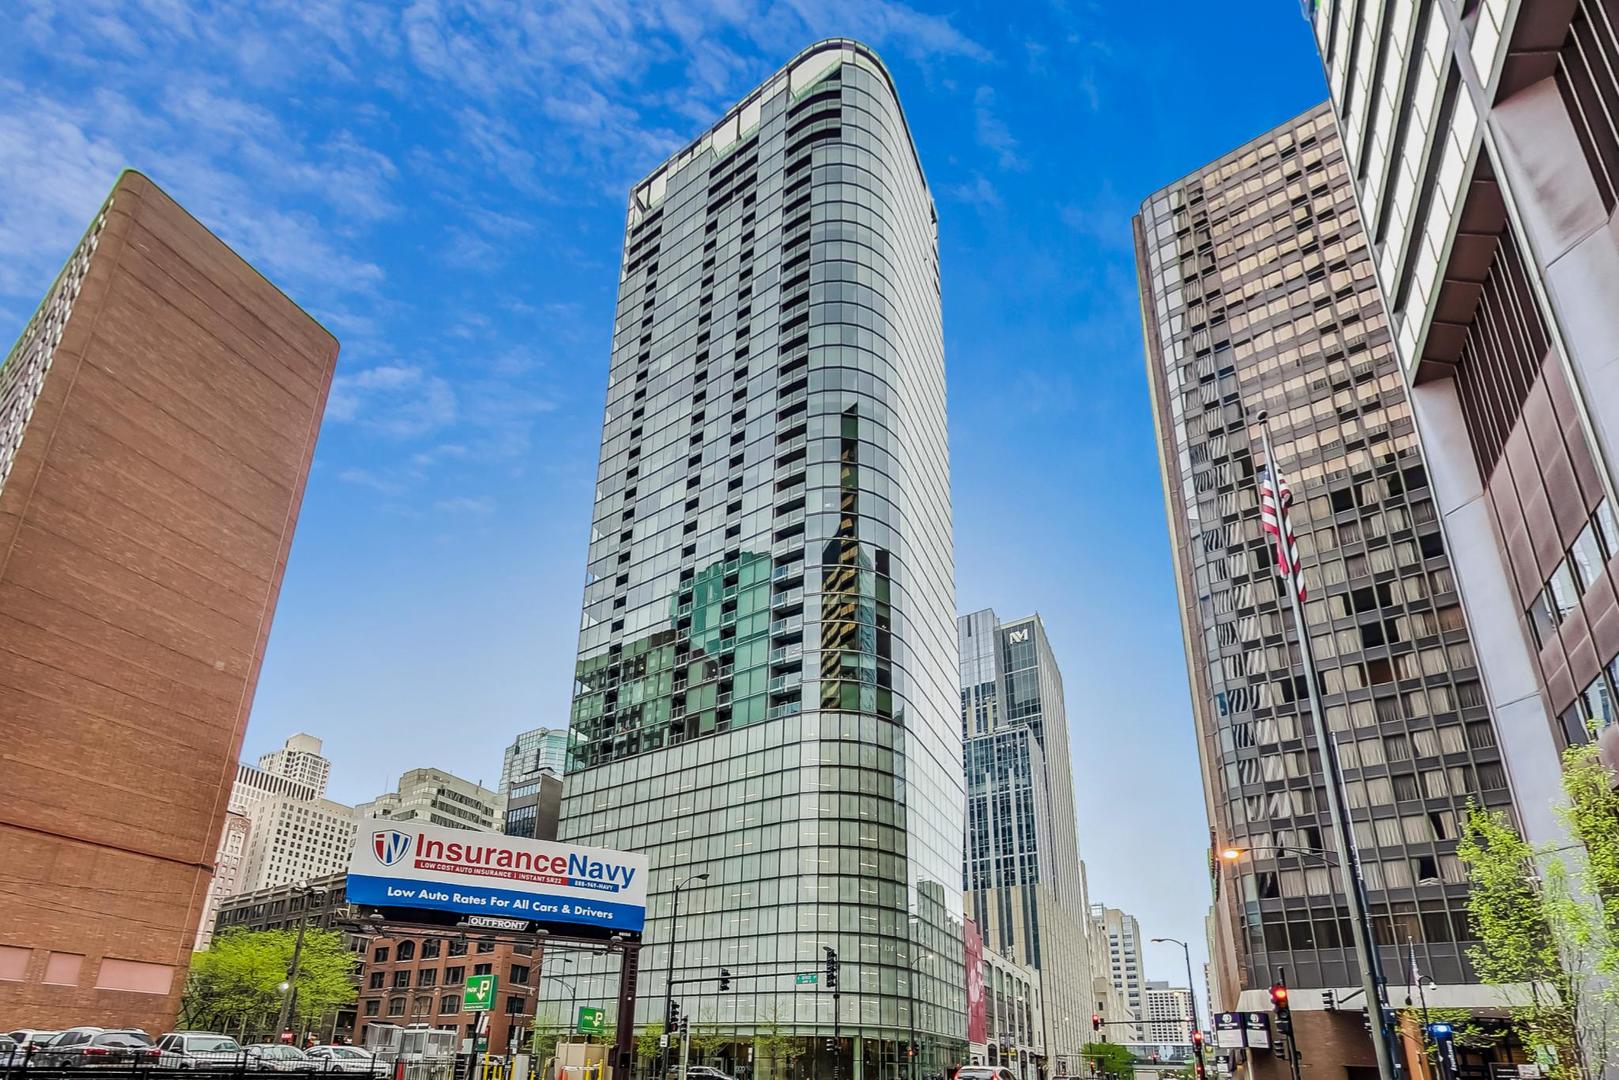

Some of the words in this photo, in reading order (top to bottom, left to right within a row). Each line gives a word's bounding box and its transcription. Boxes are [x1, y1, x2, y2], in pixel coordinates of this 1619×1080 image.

[415, 833, 636, 889] InsuranceNavy
[456, 866, 472, 874] AUTO
[474, 869, 512, 878] INSURANCE
[519, 873, 545, 882] INSTANT
[387, 886, 416, 898] Low
[418, 889, 449, 901] Auto
[453, 893, 487, 905] Rates
[490, 896, 510, 907] For
[513, 899, 529, 910] All
[532, 902, 558, 913] Cars
[561, 904, 571, 914] &
[574, 906, 614, 919] Drivers
[471, 917, 525, 930] OUTFRONT
